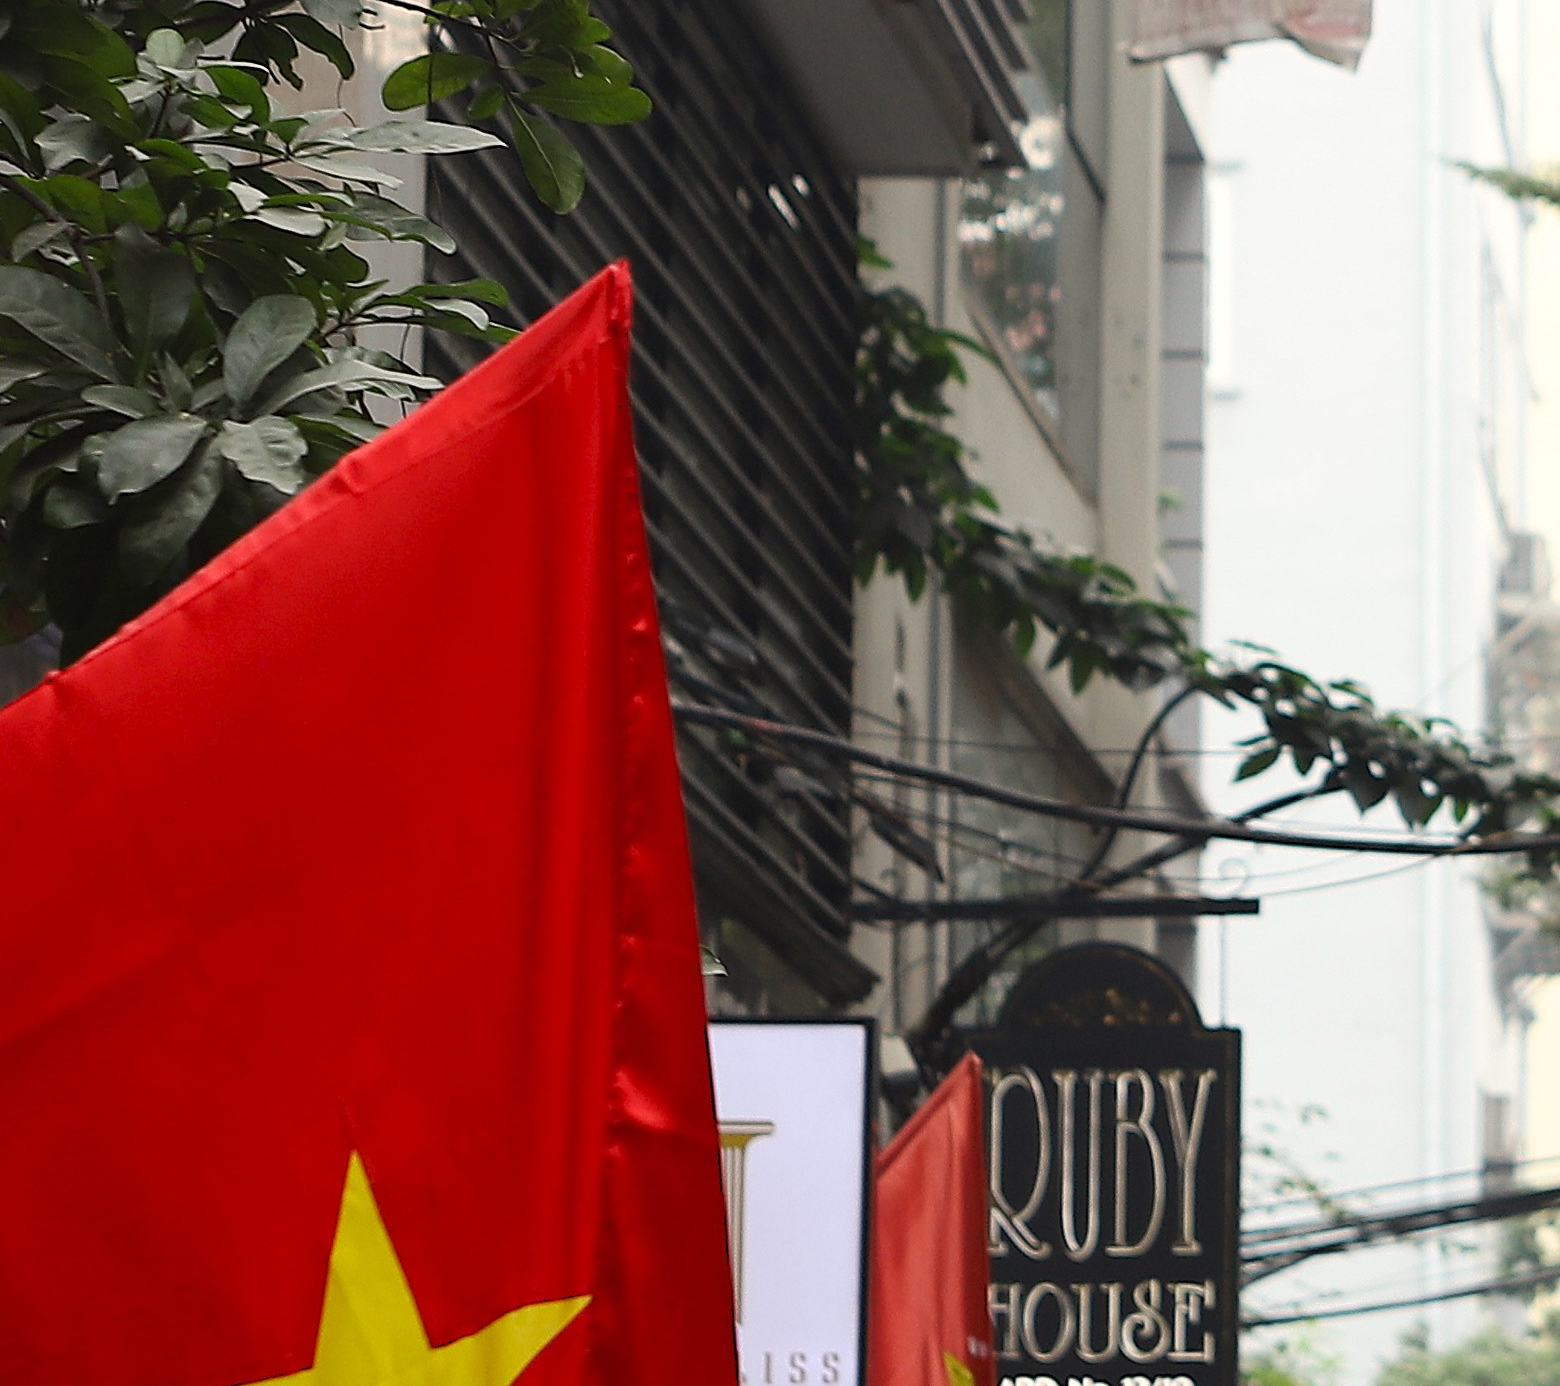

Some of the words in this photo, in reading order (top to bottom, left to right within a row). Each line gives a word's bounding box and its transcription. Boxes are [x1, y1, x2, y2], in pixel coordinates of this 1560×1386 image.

[987, 1065, 1218, 1262] RUBY
[987, 1279, 1216, 1364] HOUSE
[742, 1353, 840, 1385] ISS
